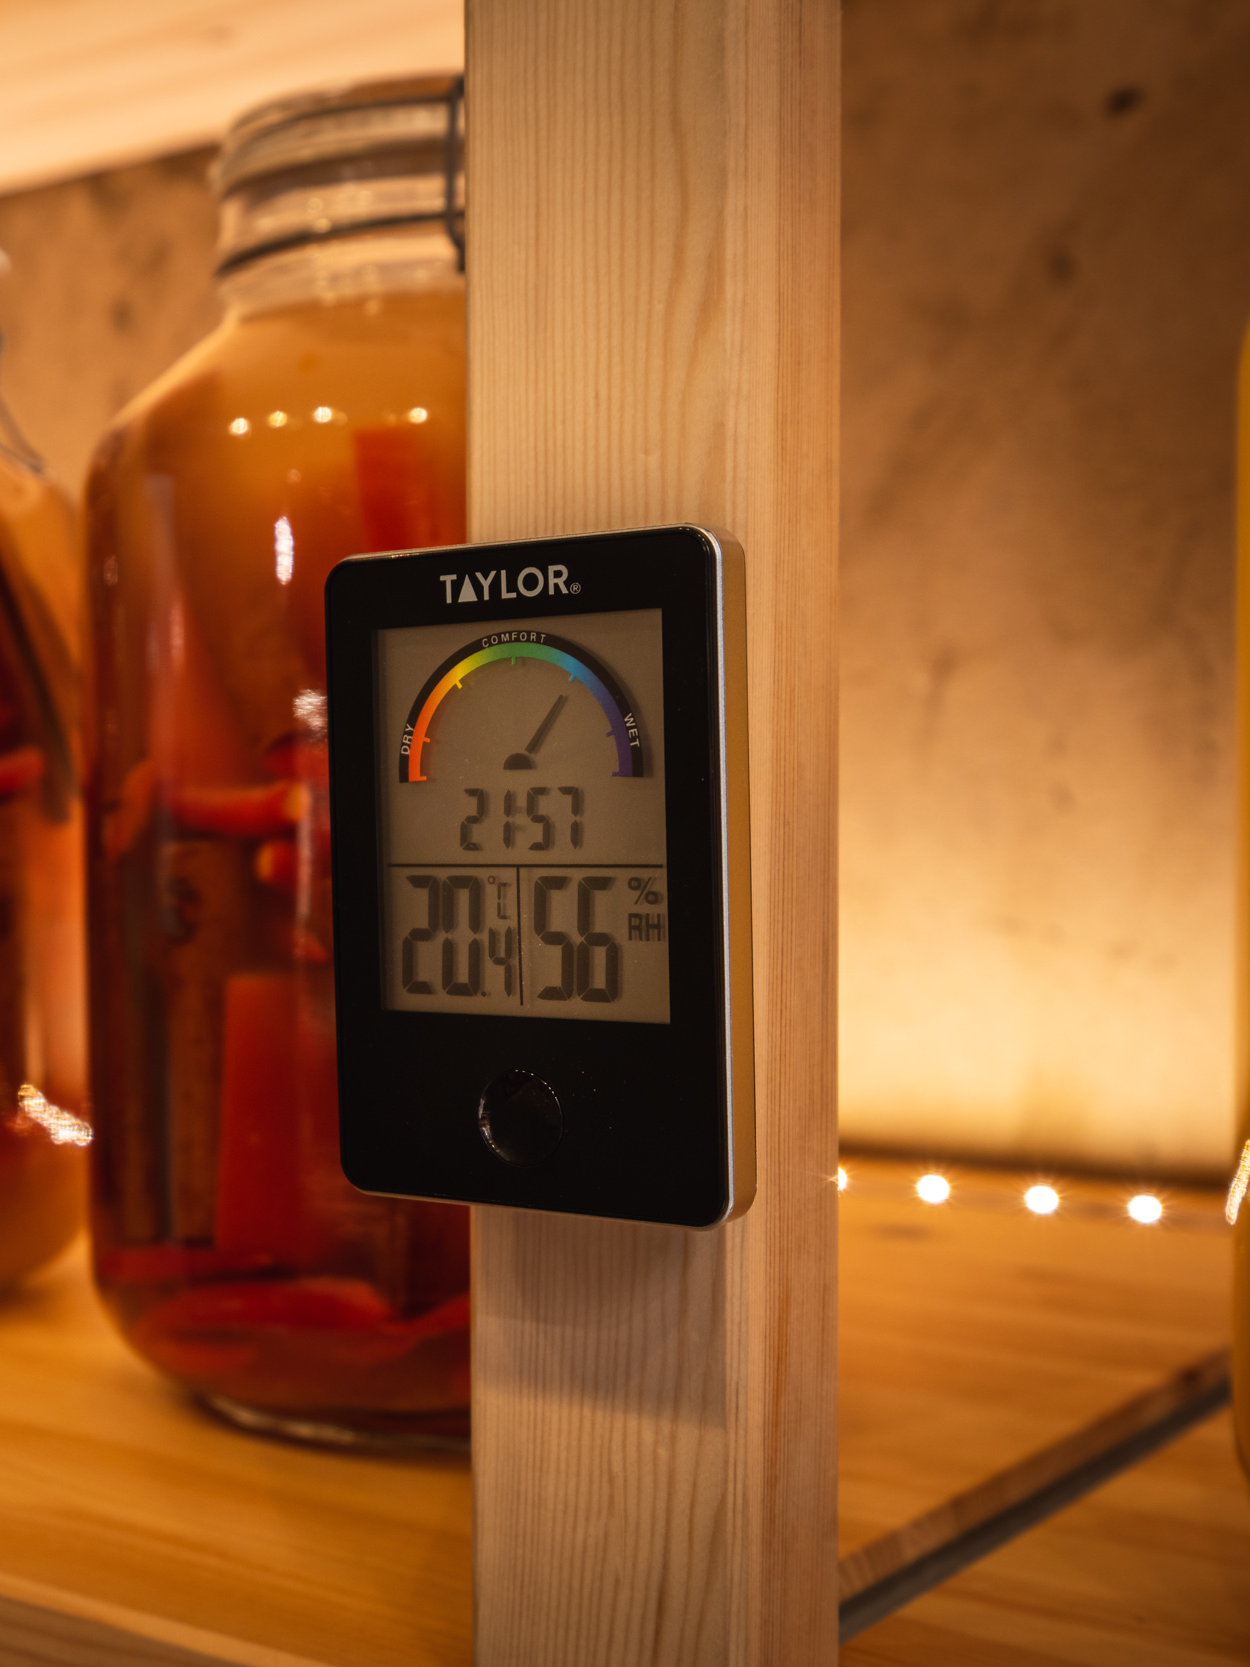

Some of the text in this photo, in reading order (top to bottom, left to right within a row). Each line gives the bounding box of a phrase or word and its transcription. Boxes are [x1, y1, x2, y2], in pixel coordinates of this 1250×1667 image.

[481, 631, 547, 648] COMFORT
[400, 723, 414, 755] DRY
[624, 712, 640, 747] WET
[534, 875, 660, 1002] 56 %
[627, 912, 662, 942] RH
